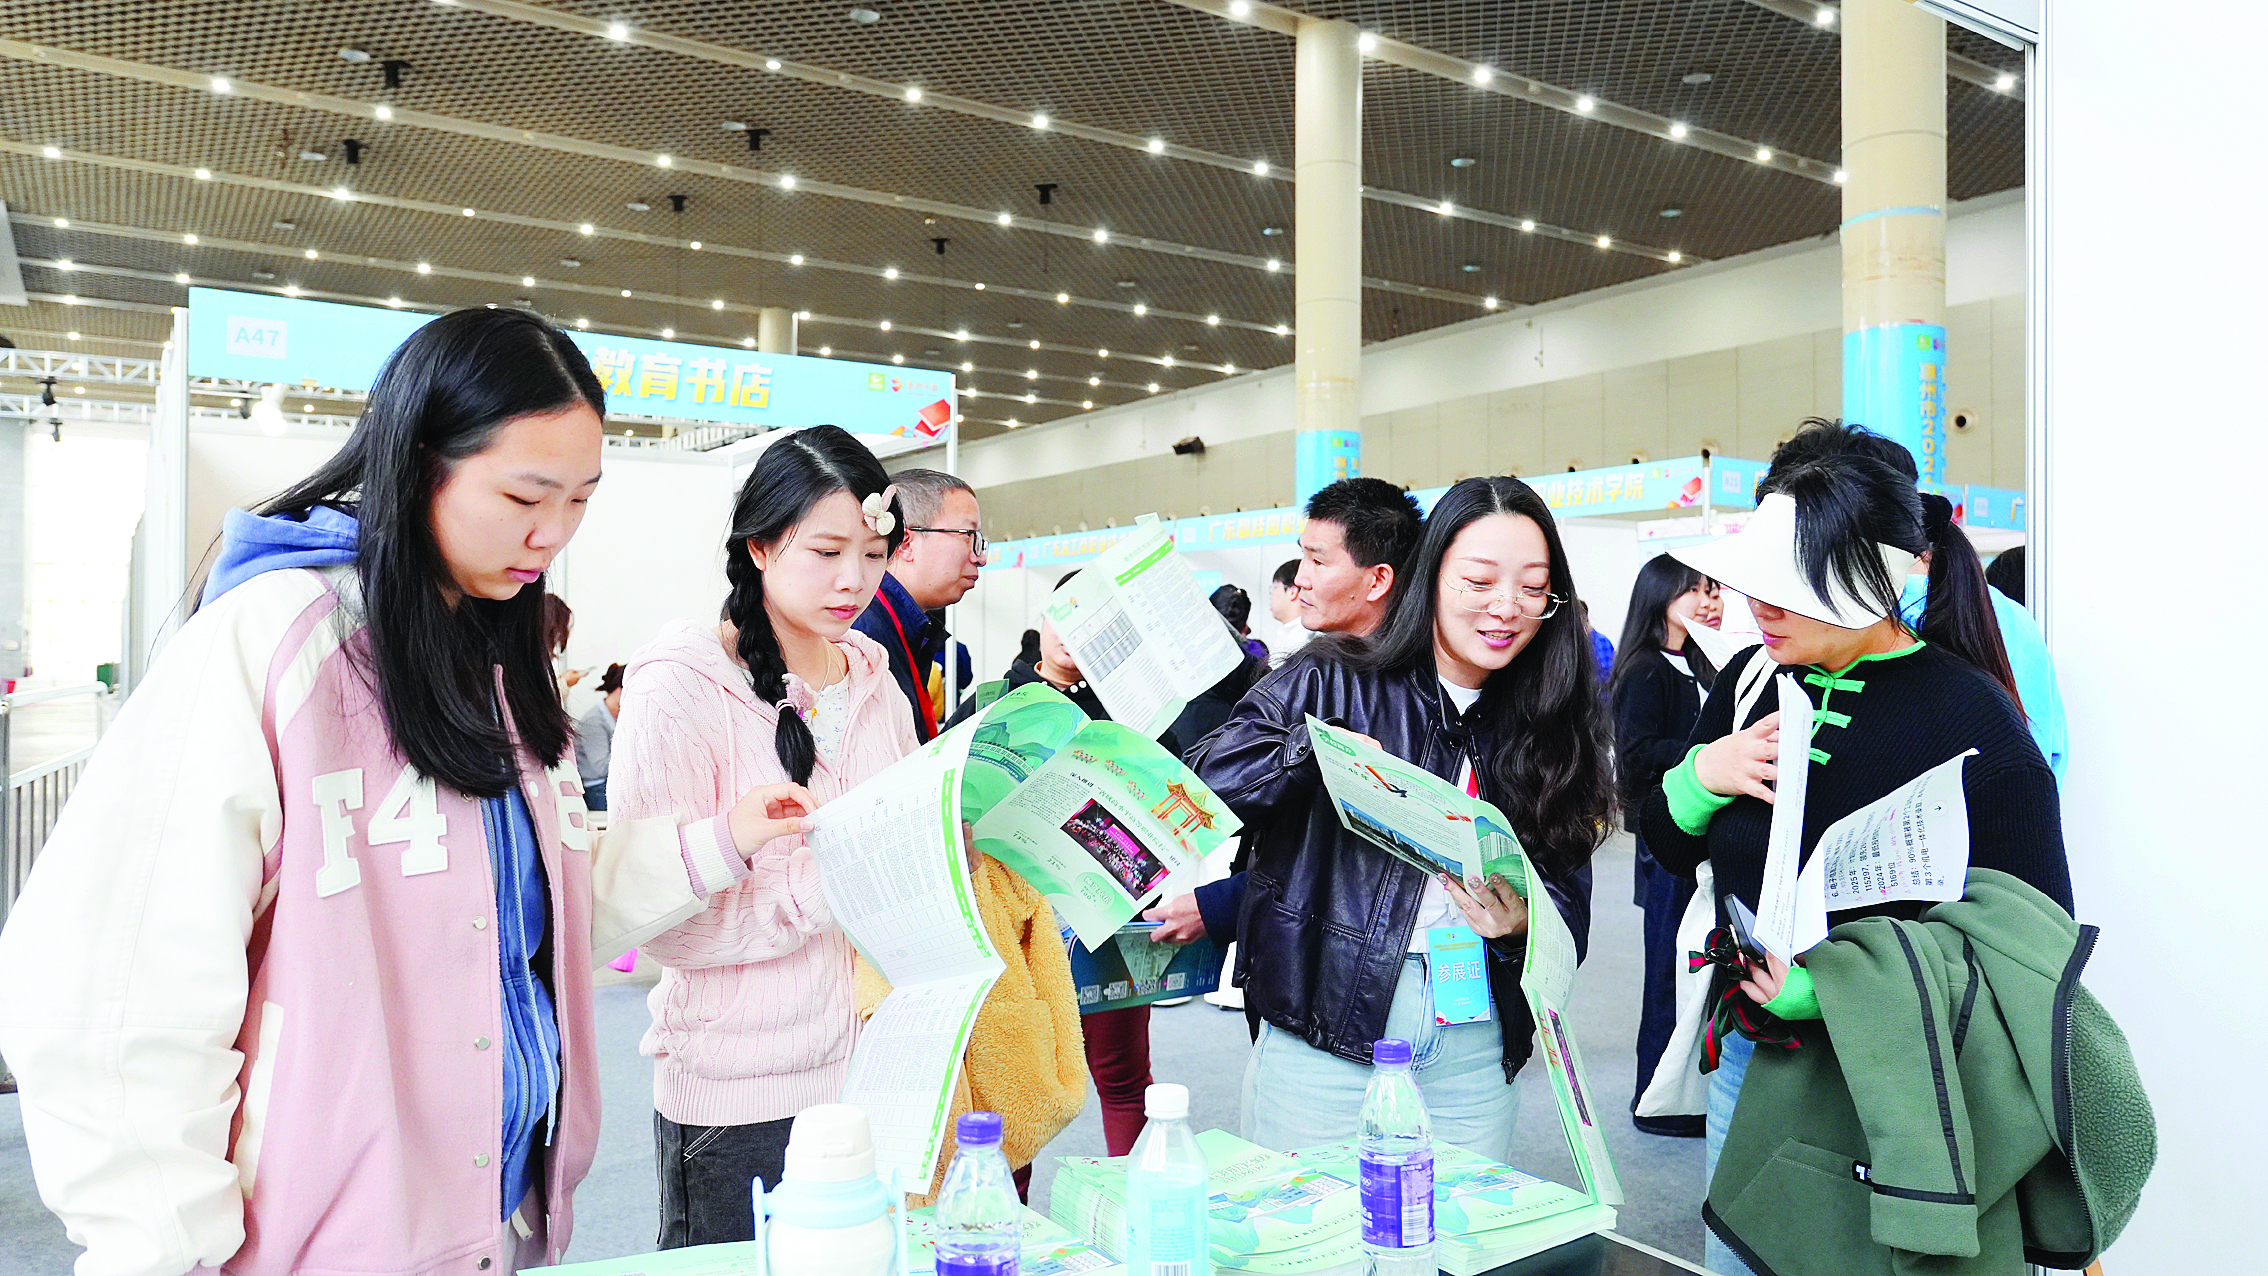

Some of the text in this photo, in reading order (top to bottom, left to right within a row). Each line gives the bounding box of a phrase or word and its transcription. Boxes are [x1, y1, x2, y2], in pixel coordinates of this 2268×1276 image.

[235, 326, 280, 346] A47
[583, 346, 773, 409] 教育书店
[1437, 960, 1481, 984] 参展证
